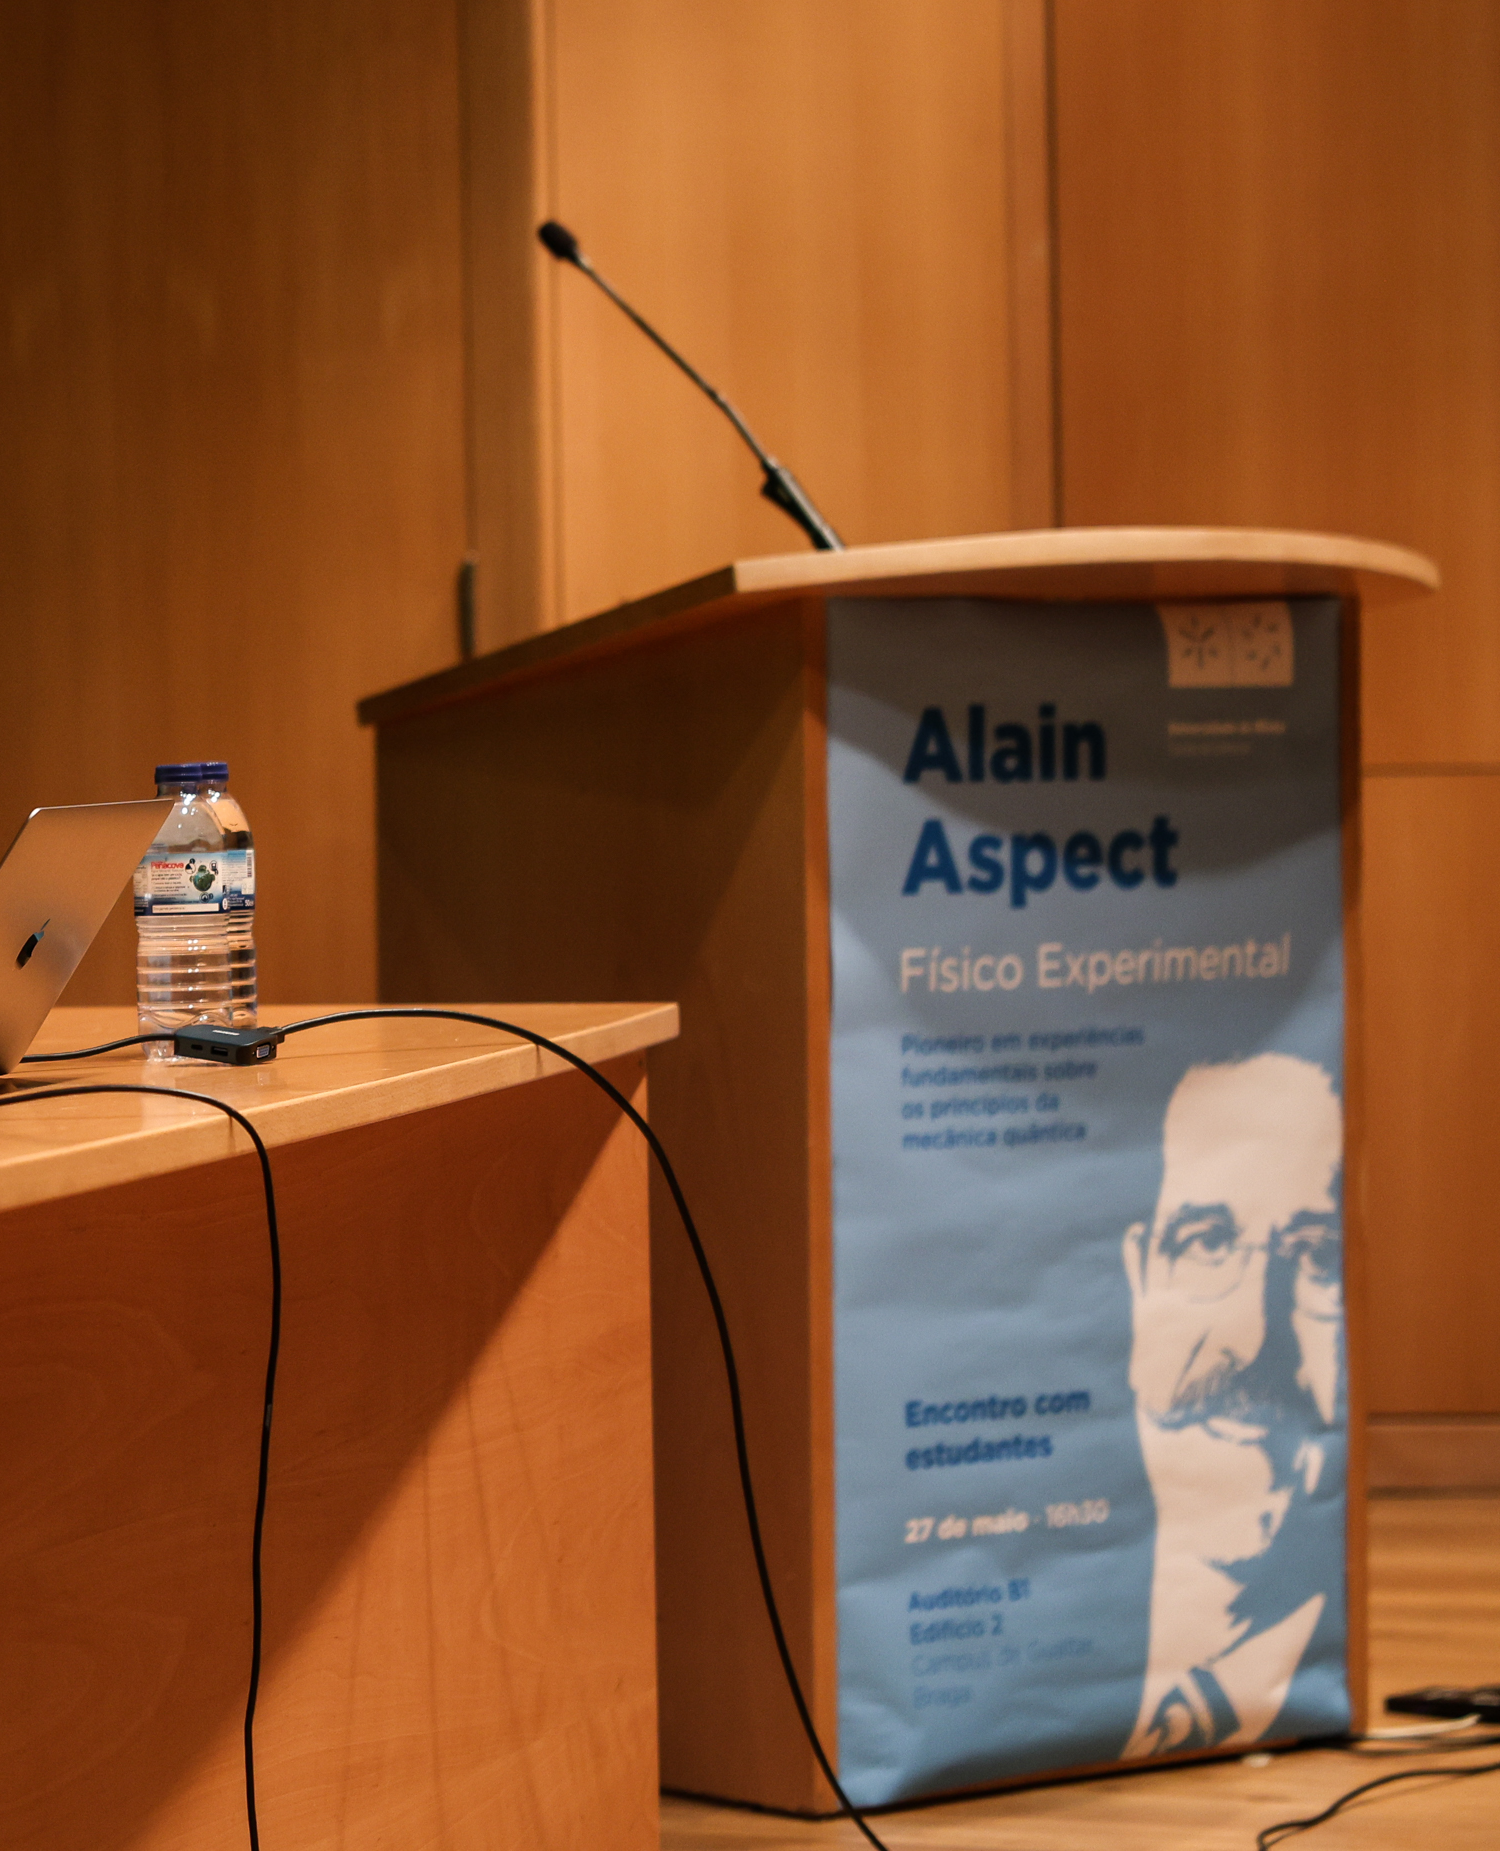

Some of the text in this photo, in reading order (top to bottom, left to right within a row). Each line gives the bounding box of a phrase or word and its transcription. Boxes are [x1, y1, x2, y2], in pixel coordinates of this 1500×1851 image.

[903, 703, 1107, 783] Alain
[902, 816, 1179, 909] Aspect
[900, 933, 1291, 994] Físico Experimental
[901, 1032, 984, 1055] Pioneiro
[991, 1033, 1022, 1052] em
[901, 1060, 1097, 1087] fundamentais sobre
[901, 1101, 924, 1119] os
[1035, 1092, 1060, 1112] da
[905, 1389, 1091, 1428] Encontro com
[905, 1434, 1054, 1471] estudantes
[904, 1516, 936, 1544] 27
[937, 1513, 968, 1541] de
[971, 1506, 1030, 1537] maio
[991, 1613, 1003, 1636] 2
